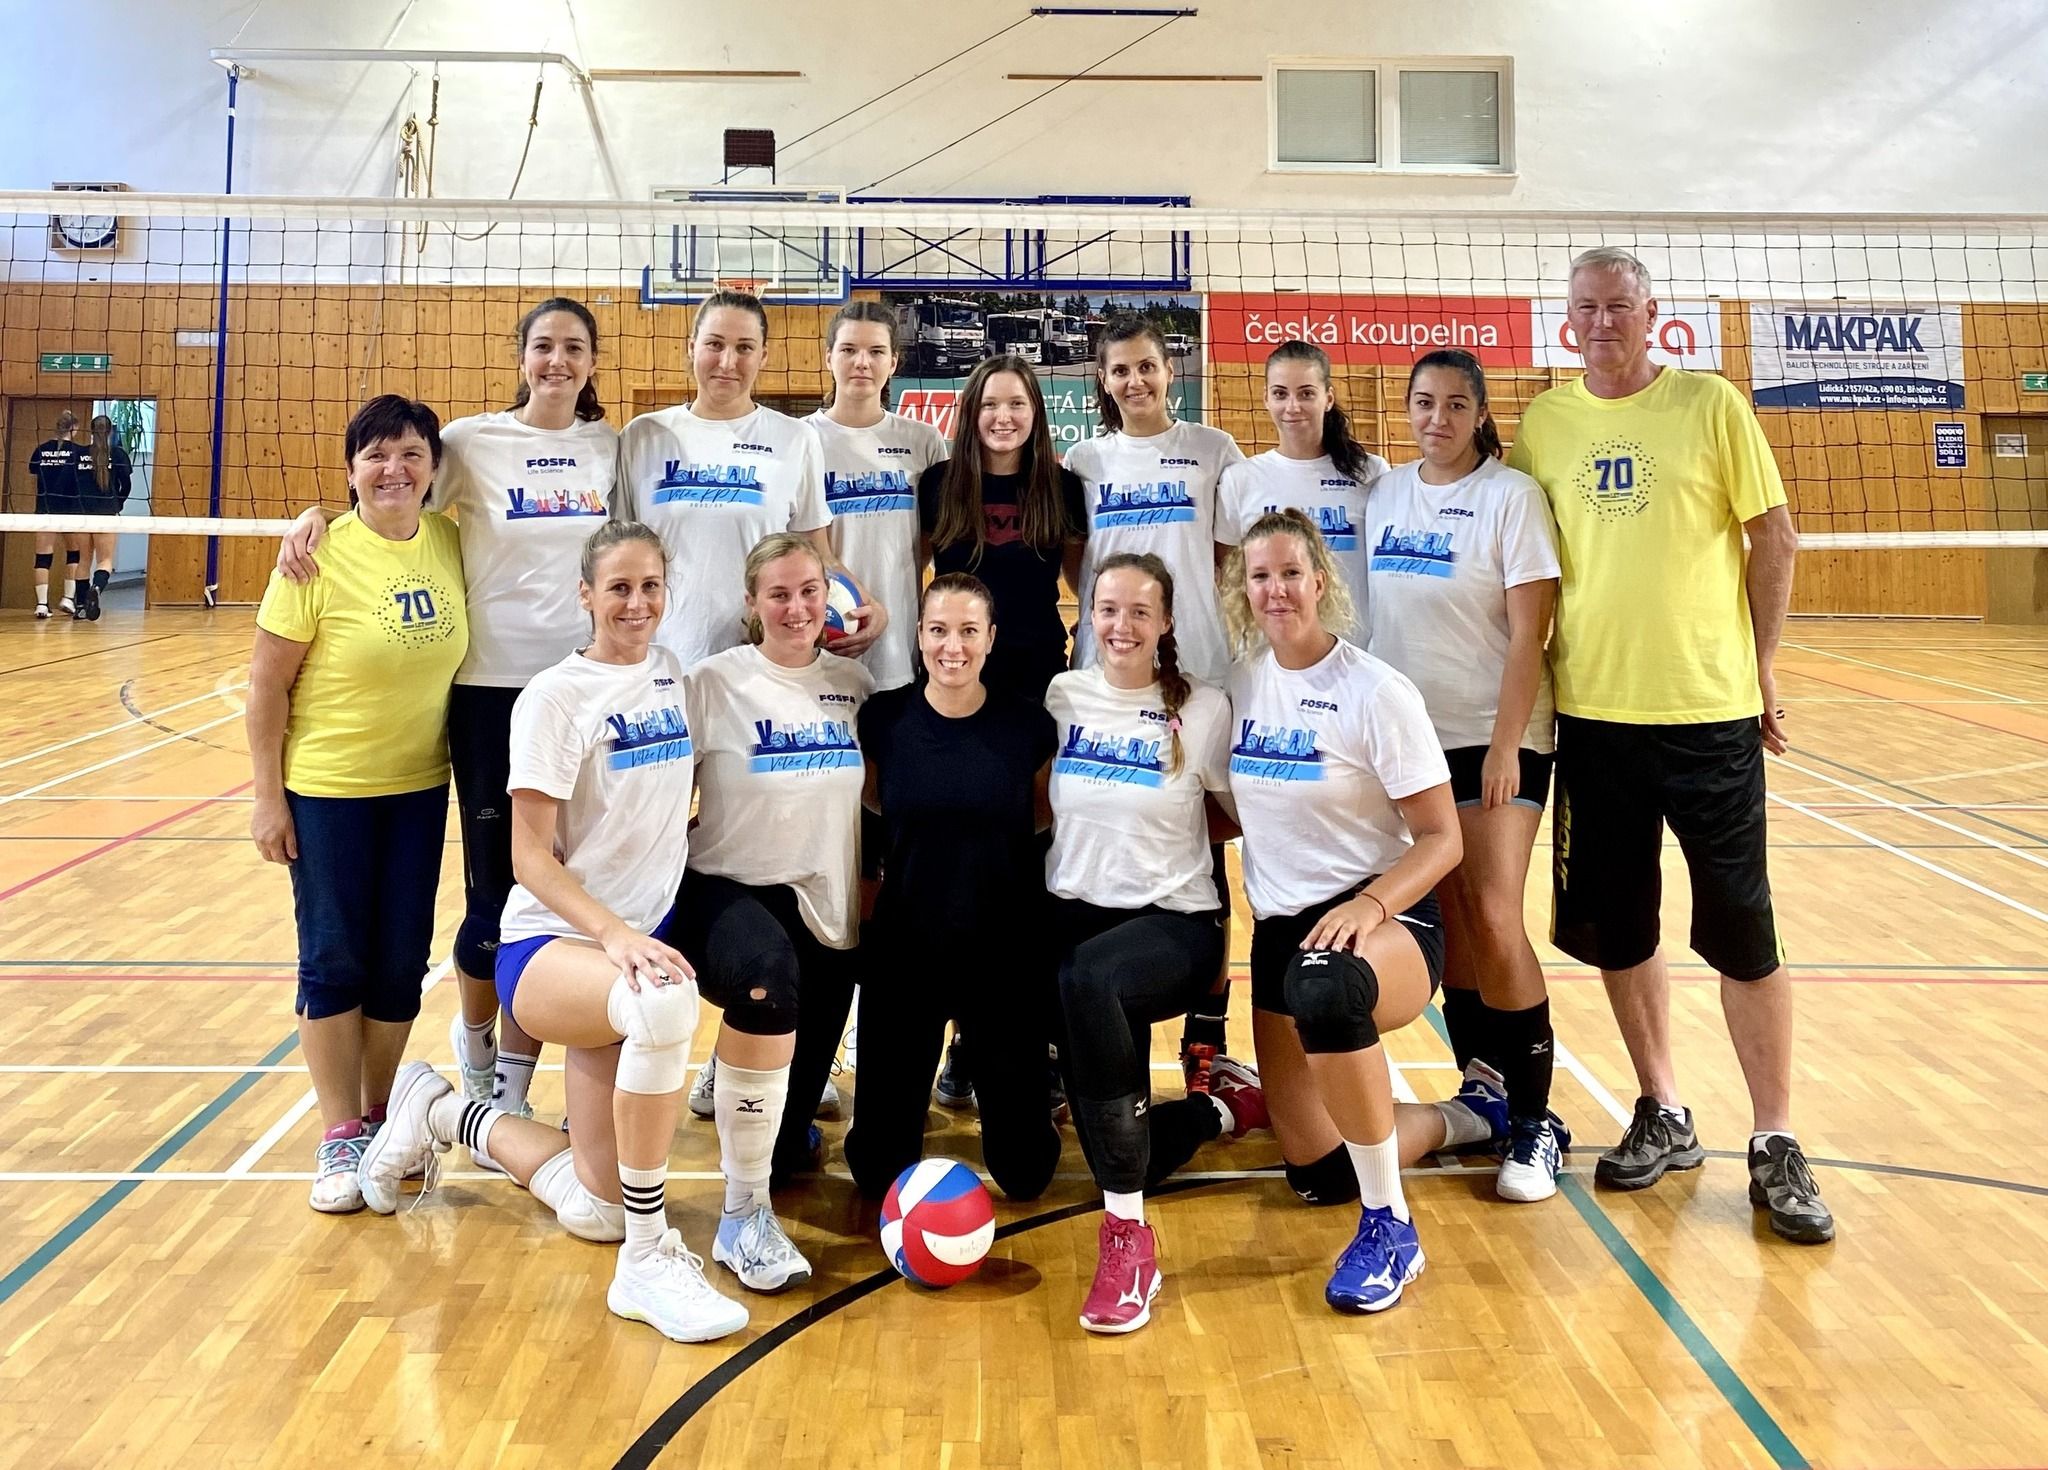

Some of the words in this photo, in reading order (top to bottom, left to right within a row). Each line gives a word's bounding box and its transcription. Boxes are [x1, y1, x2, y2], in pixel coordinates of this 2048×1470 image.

[1245, 314, 1338, 344] česká
[1351, 316, 1498, 352] koupelna
[1784, 316, 1925, 352] MAKPAK
[1819, 384, 1844, 393] Lidická
[1937, 385, 1947, 393] CZ
[733, 443, 773, 453] FOSFA
[526, 458, 577, 468] FOSFA
[1594, 457, 1633, 490] 70
[1320, 479, 1357, 488] FOSFA
[1439, 508, 1474, 518] FOSFA
[394, 590, 435, 622] 70
[819, 694, 856, 704] FOSFA
[1300, 699, 1338, 712] FOSFA
[1140, 710, 1183, 726] FOS
